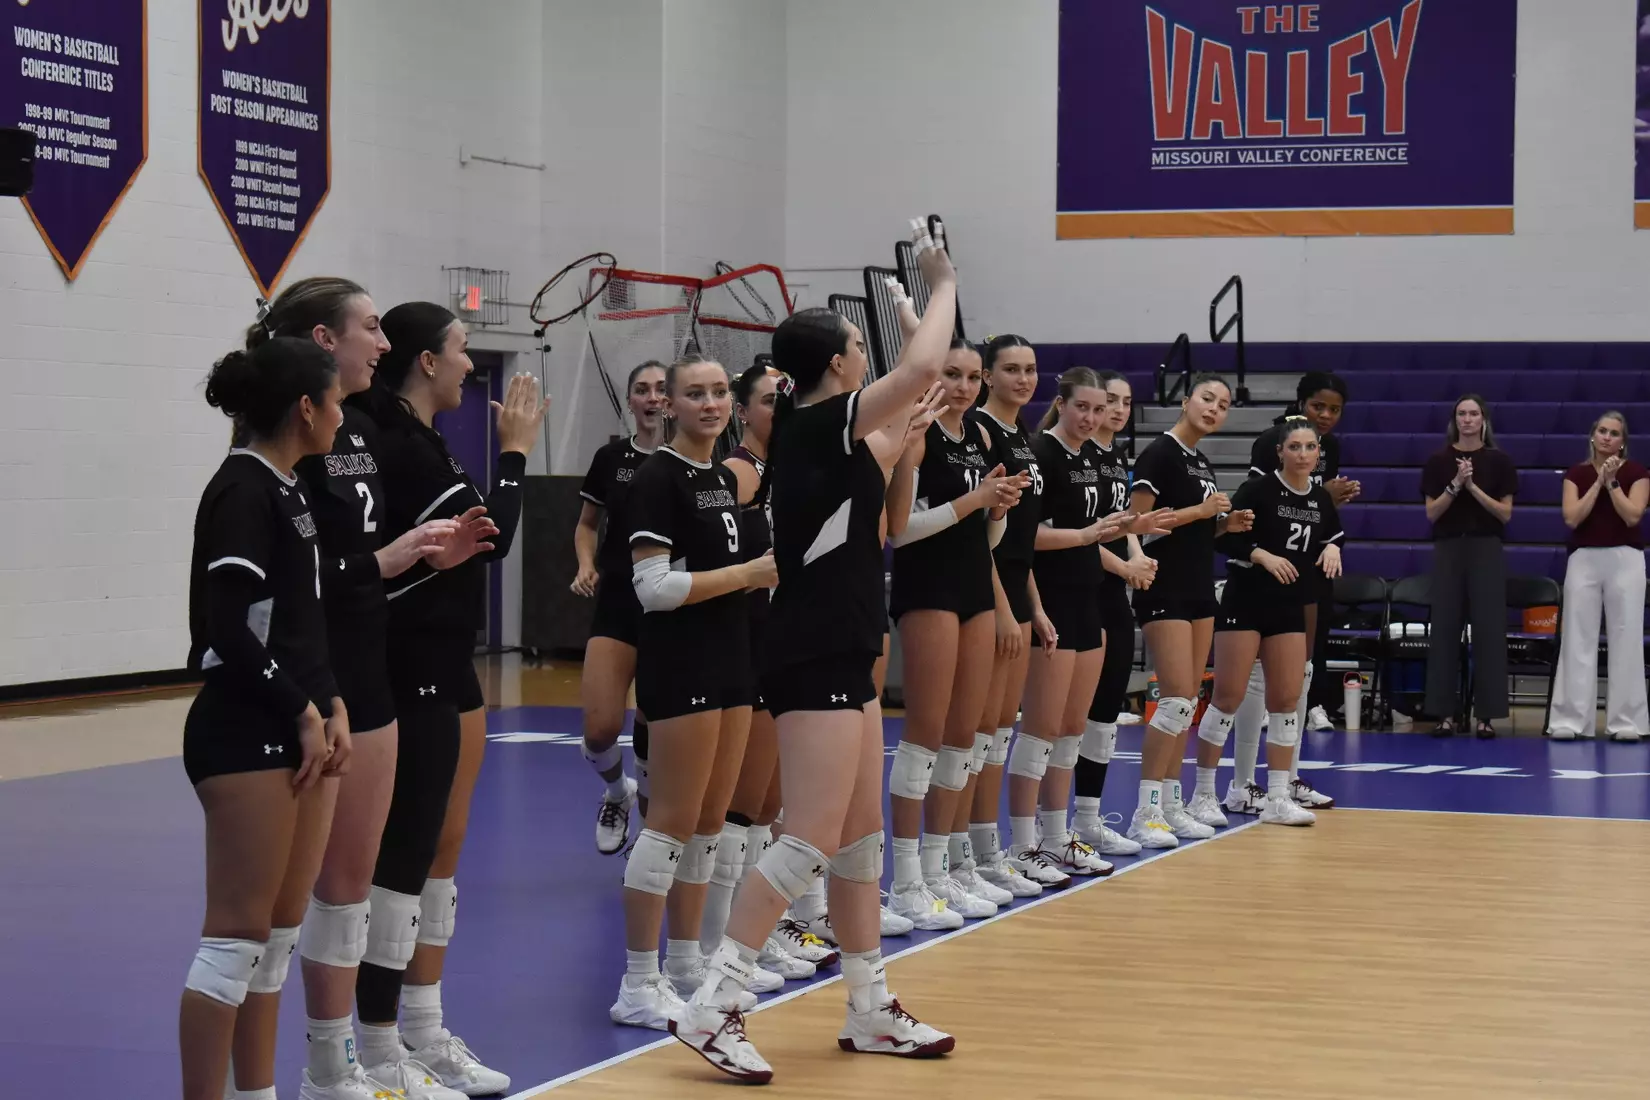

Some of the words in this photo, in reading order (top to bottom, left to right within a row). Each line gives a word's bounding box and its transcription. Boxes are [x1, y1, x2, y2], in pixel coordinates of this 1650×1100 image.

[1237, 5, 1320, 34] THE
[14, 26, 62, 54] WOMEN'S
[64, 36, 120, 66] BASKETBALL
[21, 57, 82, 88] CONFERENCE
[84, 68, 114, 92] TITLES
[1146, 0, 1423, 141] VALLEY
[222, 69, 260, 94] WOMEN'S
[262, 78, 308, 104] BASKETBALL
[25, 102, 53, 121] 1998-99
[54, 107, 70, 123] MVC
[70, 110, 111, 130] Tournament
[211, 94, 232, 115] POST
[234, 98, 265, 122] SEASON
[266, 104, 319, 131] APPEARANCES
[48, 126, 65, 143] MVC
[66, 129, 92, 147] Regular
[92, 134, 118, 151] Season
[265, 144, 278, 159] First
[279, 147, 297, 162] Round
[54, 147, 70, 163] MVC
[70, 149, 111, 169] Tournament
[265, 162, 278, 177] First
[279, 165, 297, 179] Round
[1151, 151, 1230, 166] MISSOURI
[1237, 149, 1295, 164] VALLEY
[1300, 147, 1408, 162] CONFERENCE
[245, 177, 262, 192] WNIT
[262, 179, 282, 195] Second
[282, 183, 301, 198] Round
[265, 197, 279, 212] First
[279, 200, 297, 214] Round
[264, 214, 277, 229] First
[277, 217, 295, 232] Round
[325, 453, 377, 476] SALUKIS
[1029, 463, 1044, 495] 15
[355, 482, 377, 532] 2
[1084, 486, 1098, 517] 17
[1110, 481, 1126, 511] 18
[1277, 504, 1321, 523] SALUKIS
[721, 512, 739, 552] 9
[1286, 522, 1312, 552] 21
